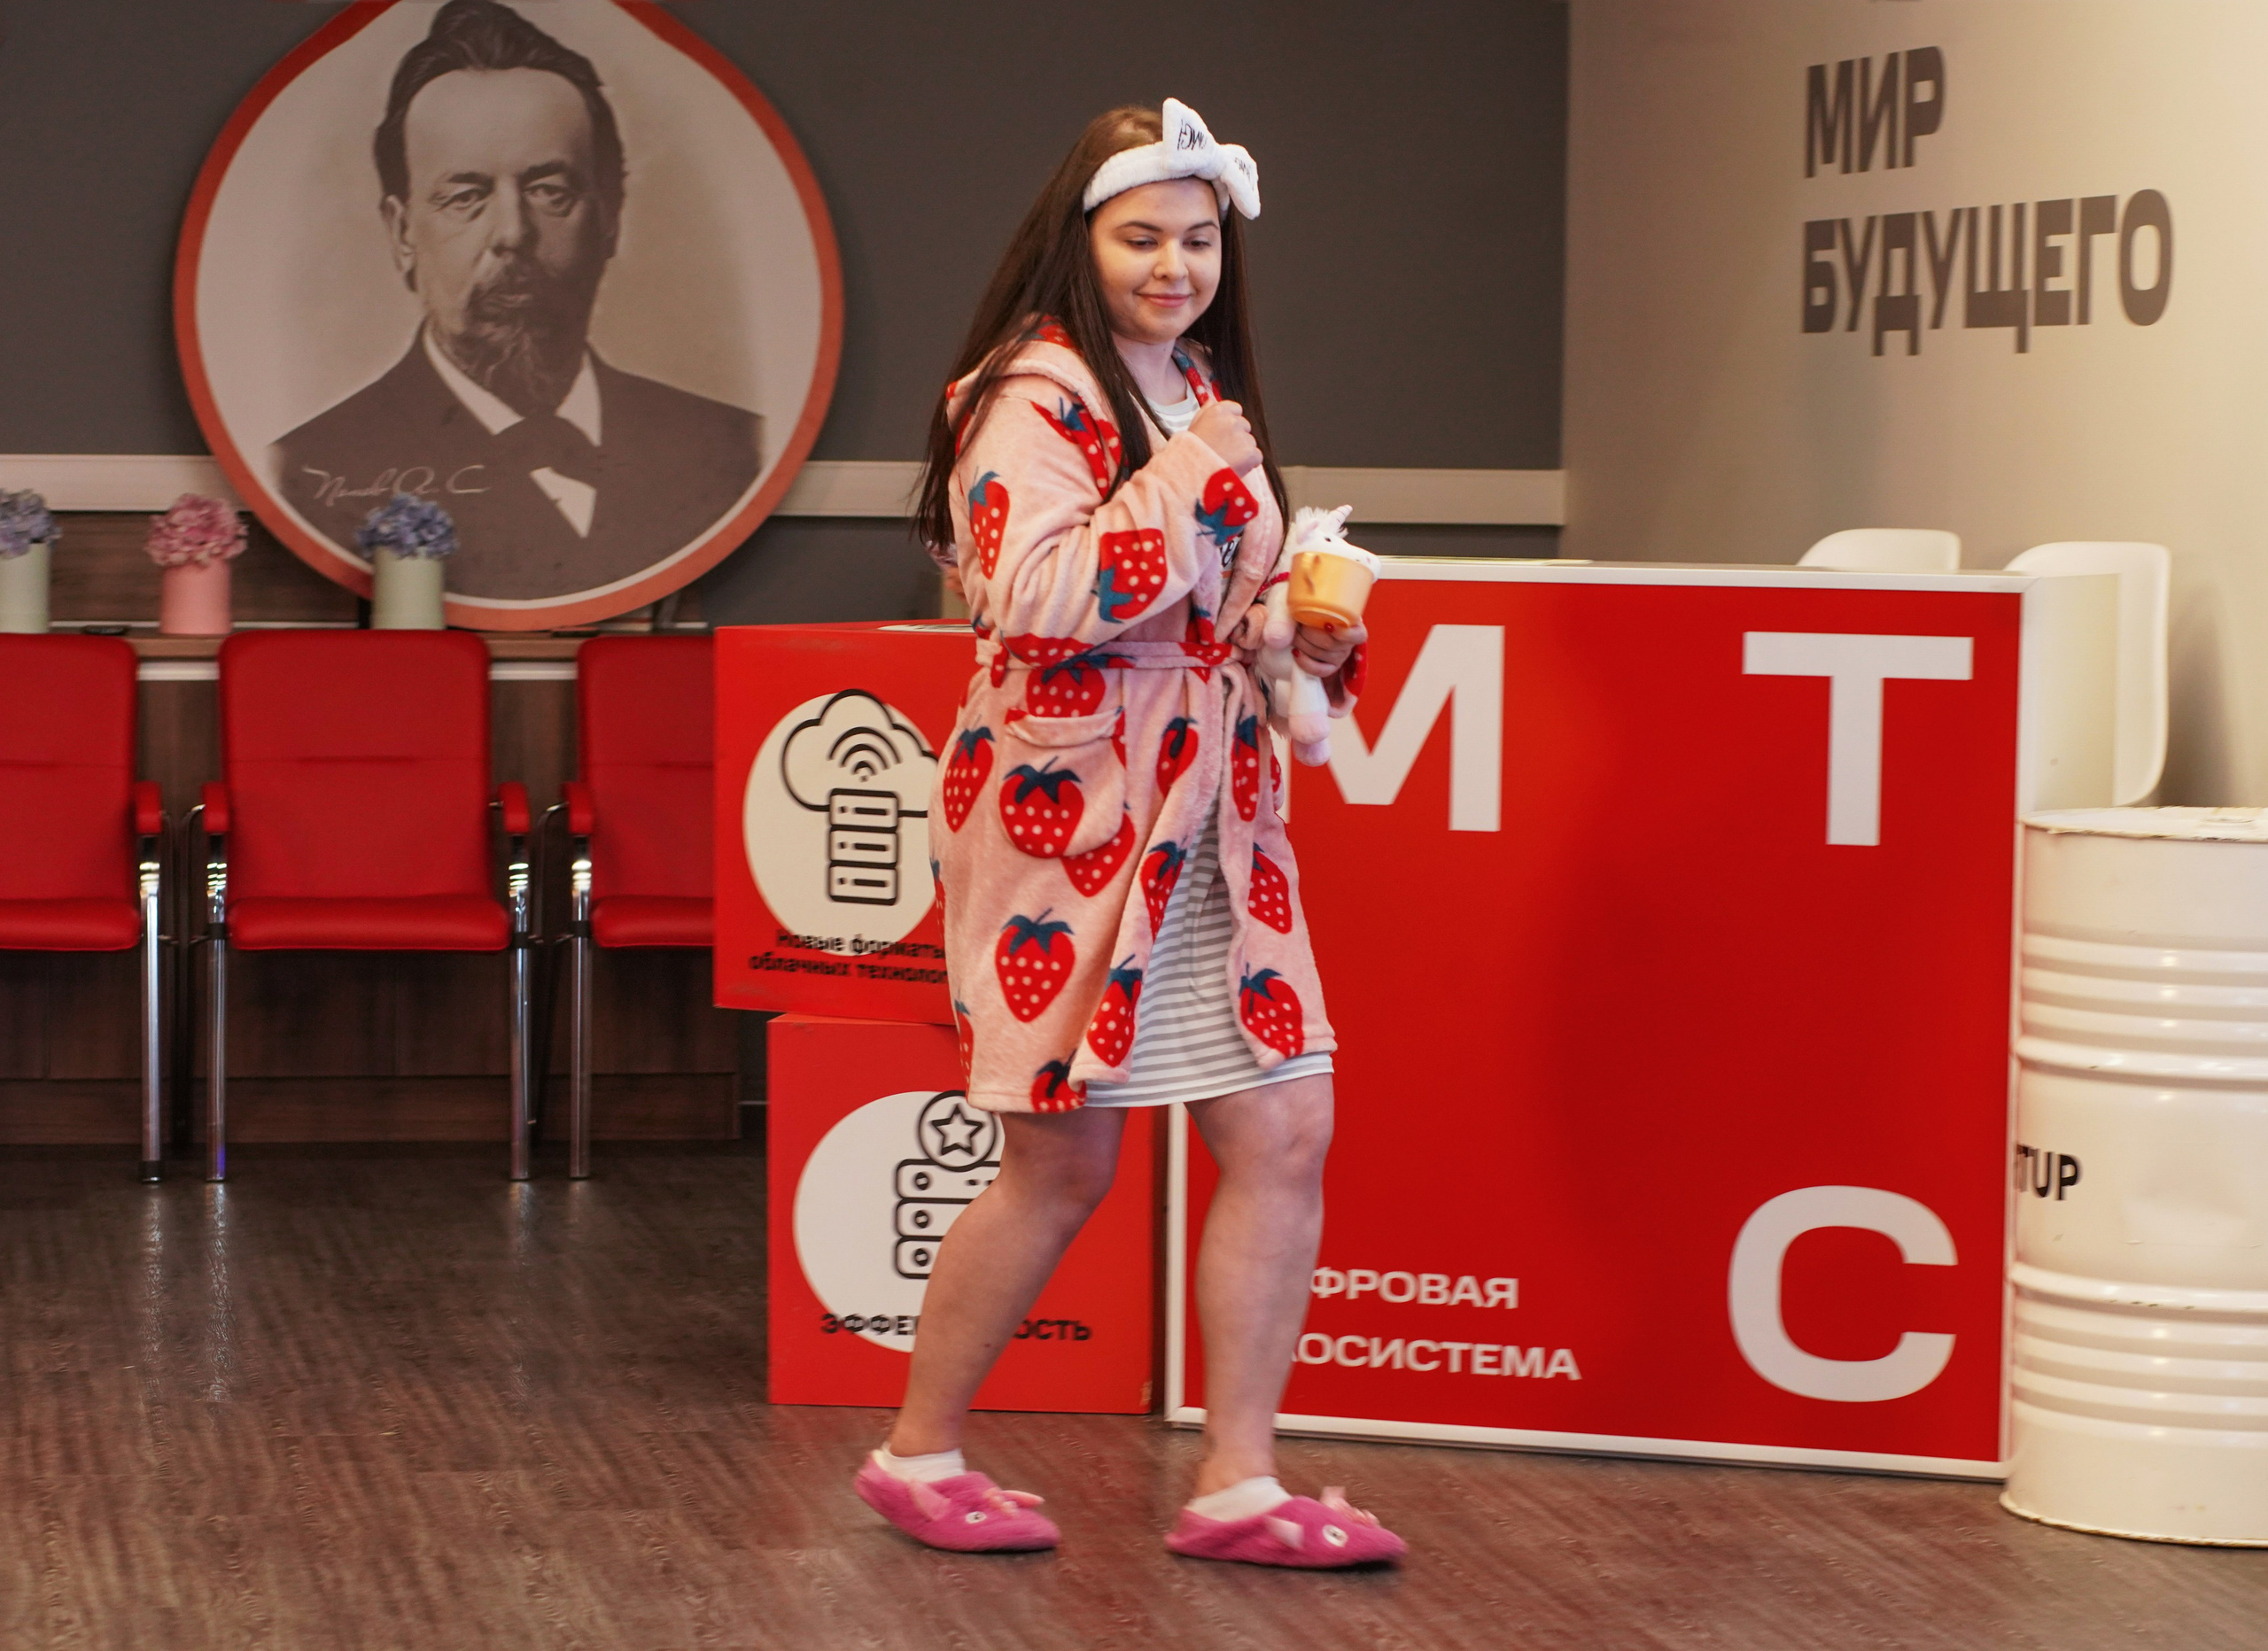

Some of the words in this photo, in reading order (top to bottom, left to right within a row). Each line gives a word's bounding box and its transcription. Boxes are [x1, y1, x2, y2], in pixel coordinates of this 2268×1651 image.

[1805, 46, 1946, 178] МИР
[1802, 189, 2174, 356] БУДУЩЕГО
[1742, 631, 1973, 847] Т
[1292, 1332, 1582, 1381] ОСИСТЕМА
[1310, 1267, 1520, 1310] ФРОВАЯ
[1728, 1184, 1959, 1403] С
